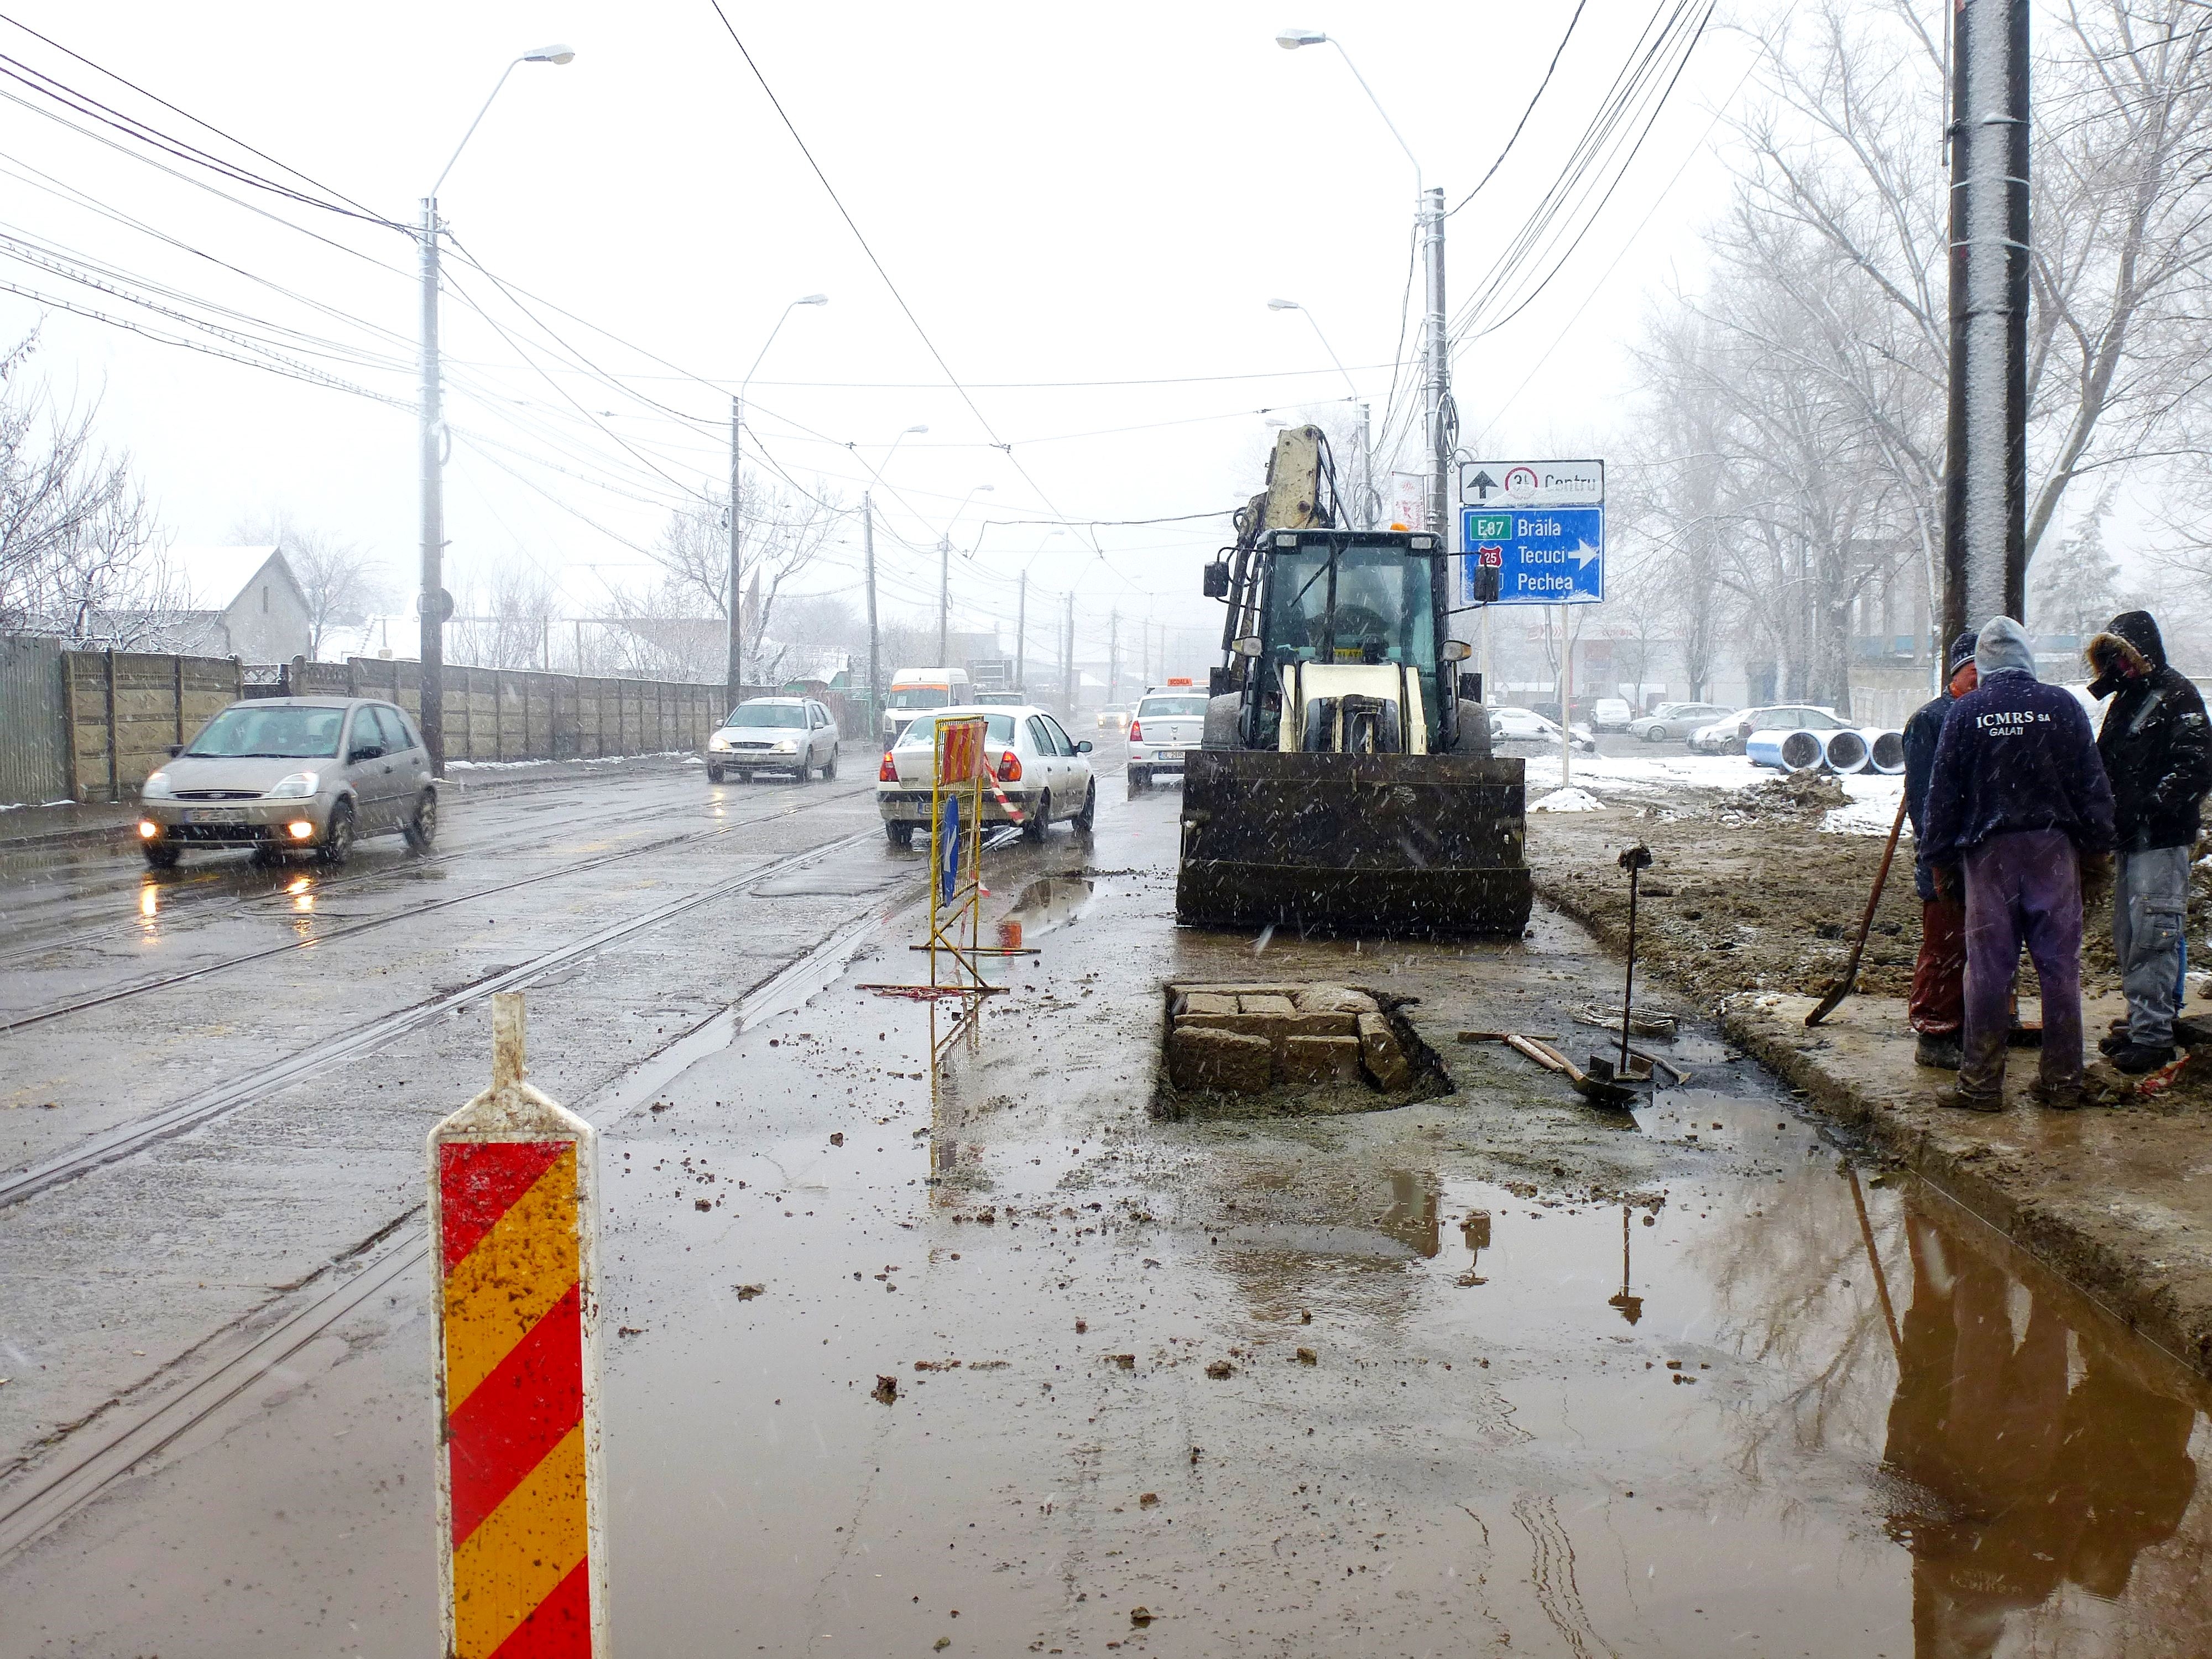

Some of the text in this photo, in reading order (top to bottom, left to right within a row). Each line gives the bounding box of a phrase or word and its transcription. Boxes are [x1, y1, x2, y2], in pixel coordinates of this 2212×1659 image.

[1478, 520, 1504, 536] E87
[1518, 518, 1561, 536] Brăila
[1484, 552, 1496, 564] 25
[1518, 546, 1565, 564] Tecuci
[1518, 573, 1573, 591] Pechea
[1976, 711, 2034, 728] ICMRS
